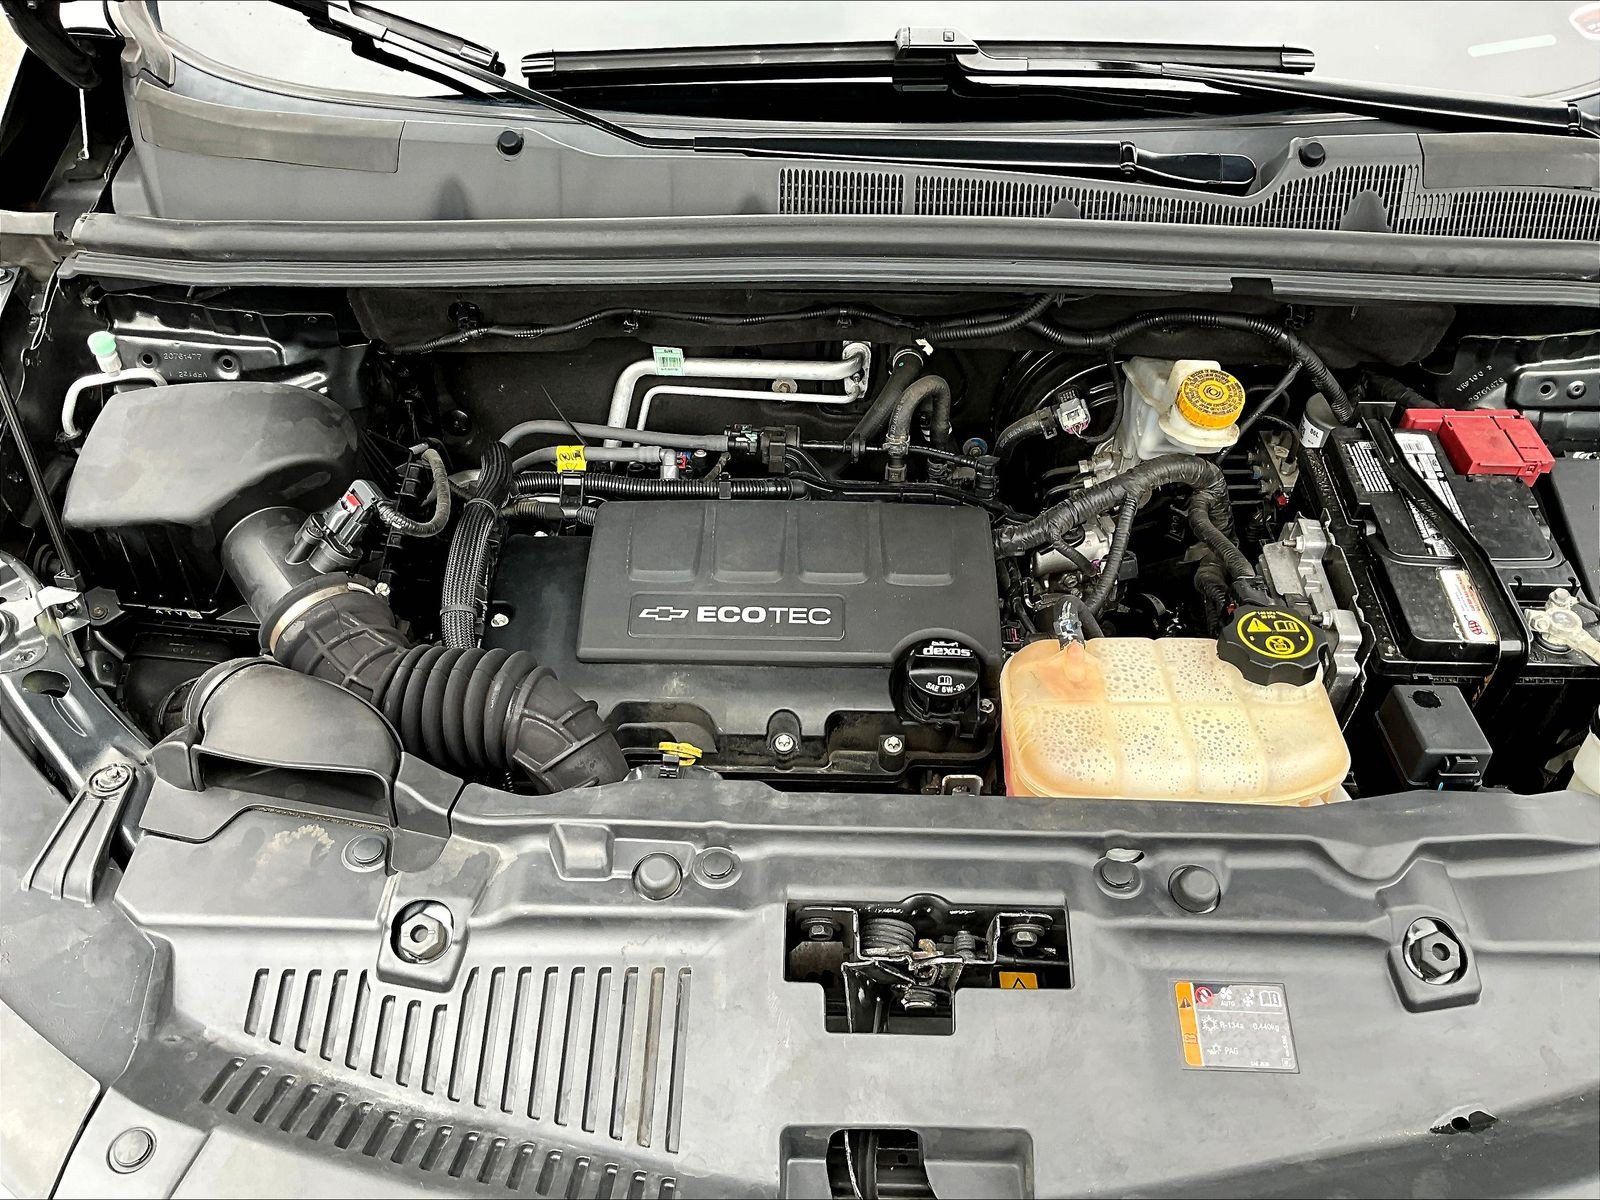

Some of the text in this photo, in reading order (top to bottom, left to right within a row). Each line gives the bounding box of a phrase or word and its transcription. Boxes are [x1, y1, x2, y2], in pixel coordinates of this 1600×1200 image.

[696, 605, 832, 626] ECOTEC
[922, 646, 971, 657] dexos
[925, 682, 940, 692] SAE
[1219, 999, 1236, 1007] AUTO
[1224, 1046, 1239, 1055] PAG
